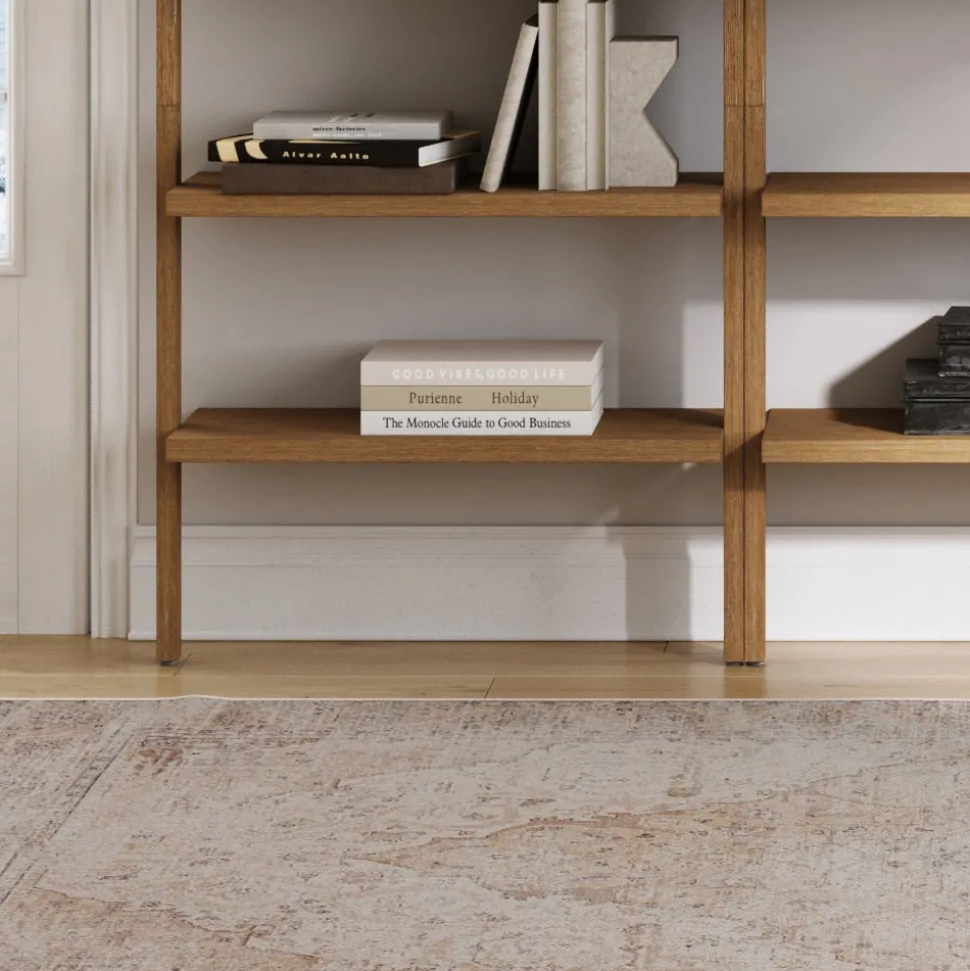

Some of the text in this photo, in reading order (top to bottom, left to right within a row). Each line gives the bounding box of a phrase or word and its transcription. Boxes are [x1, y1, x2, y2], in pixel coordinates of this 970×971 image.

[282, 151, 370, 160] Alvar Aalto
[392, 368, 433, 379] GOOD
[534, 368, 566, 379] LIFE
[409, 391, 539, 407] Purienne Holiday
[383, 417, 571, 428] The Monocle Guide to Good Business
